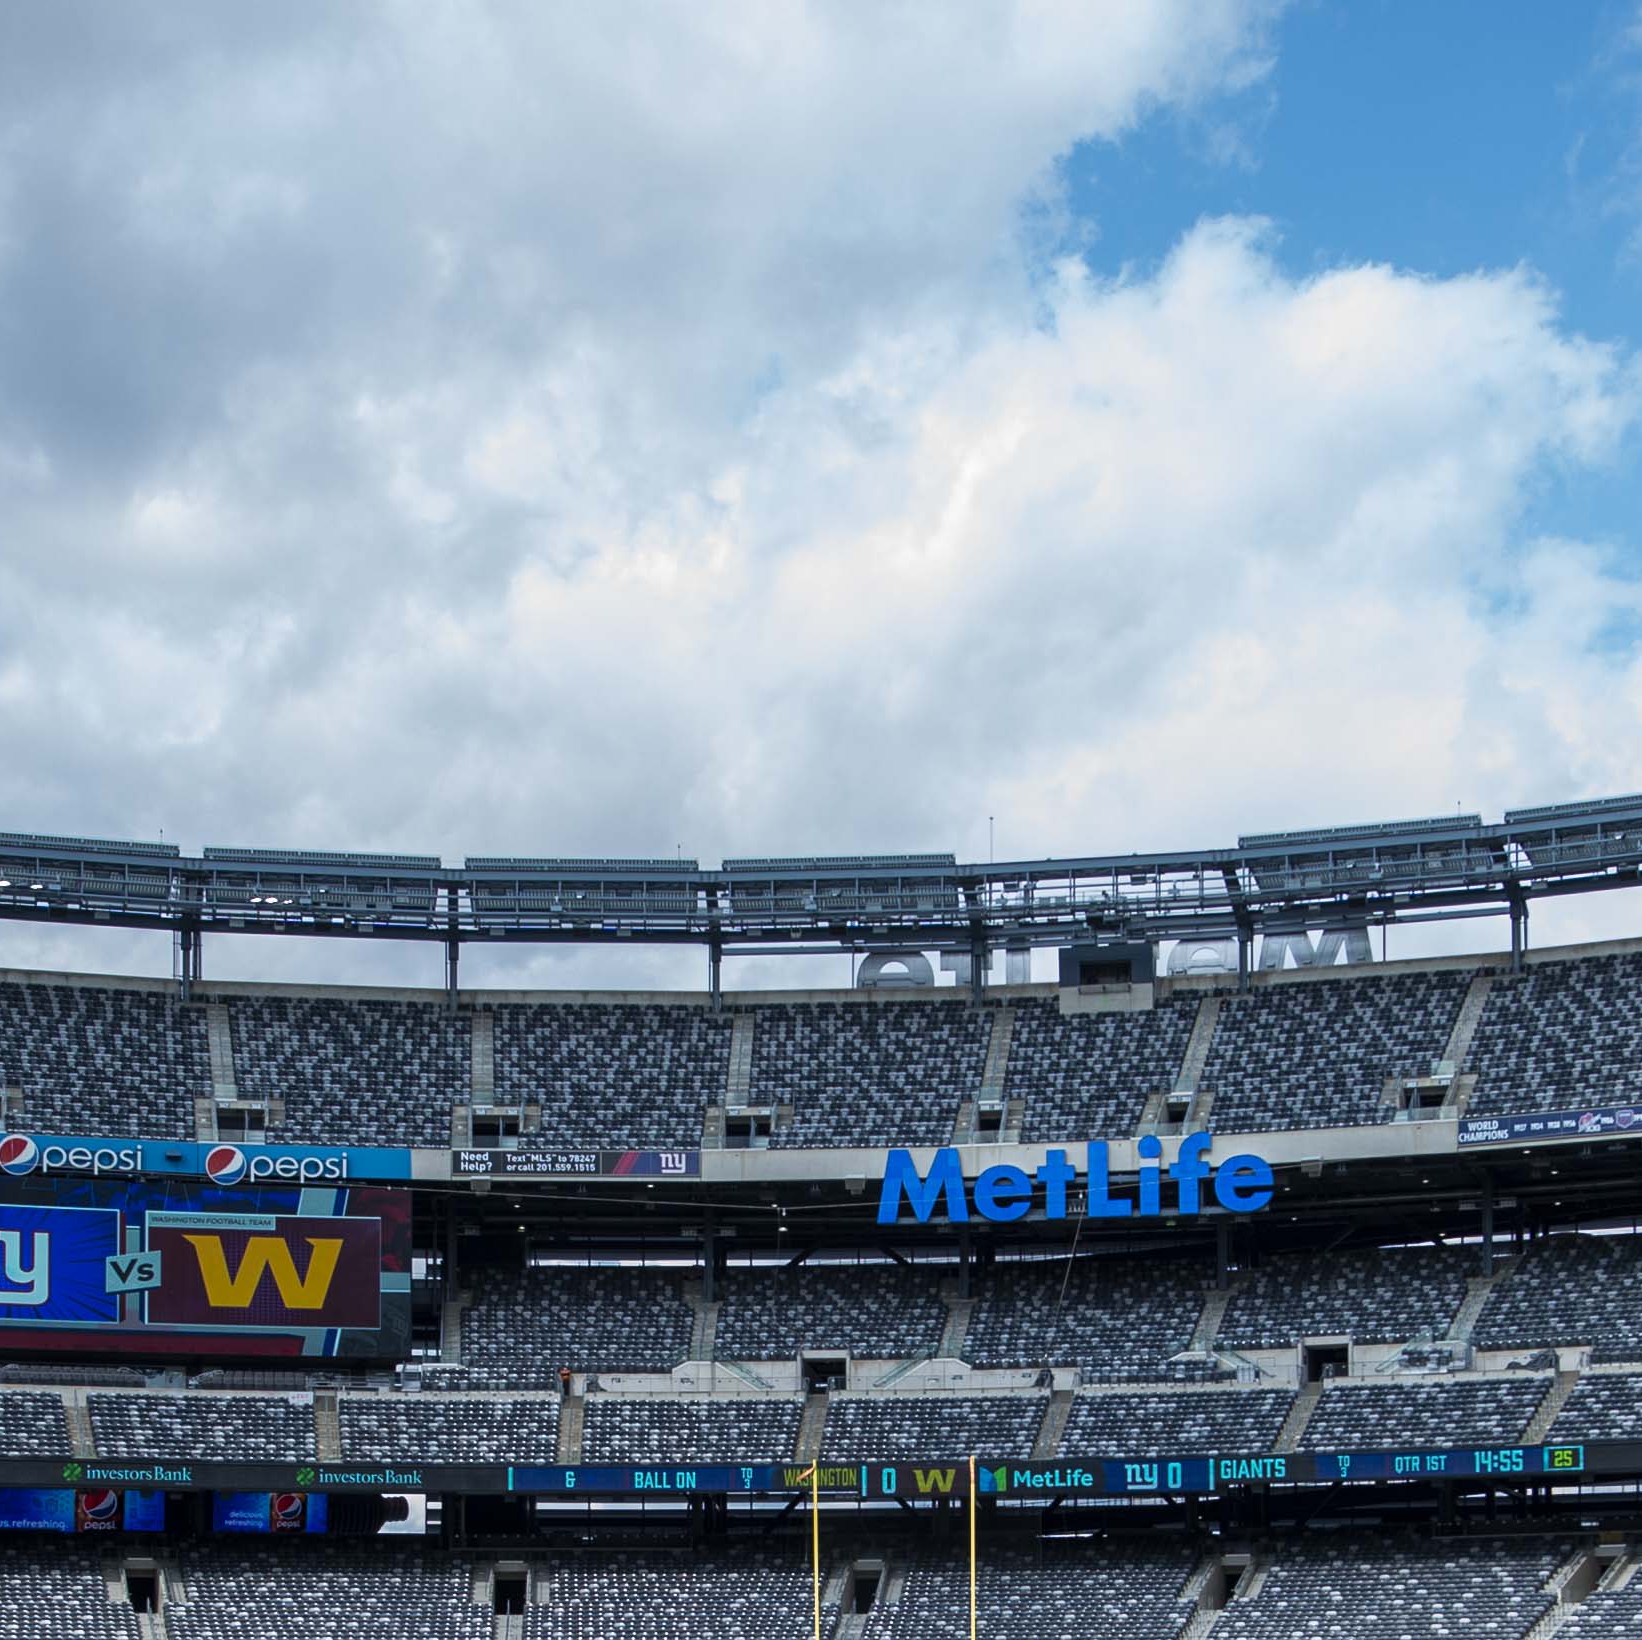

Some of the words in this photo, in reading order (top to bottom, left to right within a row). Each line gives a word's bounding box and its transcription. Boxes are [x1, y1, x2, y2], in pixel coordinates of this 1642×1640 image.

[1468, 1121, 1499, 1132] WORLD
[1458, 1130, 1509, 1143] CHAMPIONS
[41, 1144, 143, 1176] pepsi
[461, 1152, 489, 1161] Need
[507, 1154, 526, 1163] Text
[558, 1155, 568, 1163] to
[569, 1154, 596, 1163] 78247
[660, 1153, 686, 1174] ny
[249, 1152, 349, 1183] pepsi
[460, 1162, 493, 1172] Help?
[507, 1164, 516, 1172] or
[517, 1163, 535, 1172] call
[876, 1131, 1276, 1224] MetLife
[182, 1234, 343, 1308] W
[1395, 1456, 1421, 1472] QTR
[1426, 1455, 1446, 1472] 1ST
[1474, 1450, 1523, 1473] 14:55
[1553, 1451, 1573, 1467] 25
[85, 1465, 192, 1483] investorsBank
[319, 1469, 422, 1485] investorsBank
[1014, 1468, 1093, 1489] MetLife
[1125, 1463, 1157, 1490] ny
[1168, 1462, 1182, 1489] 0
[1220, 1458, 1286, 1480] GIANTS
[566, 1471, 575, 1487] &
[635, 1471, 671, 1488] BALL
[676, 1471, 696, 1488] ON
[882, 1468, 896, 1494] 0
[912, 1468, 956, 1493] W
